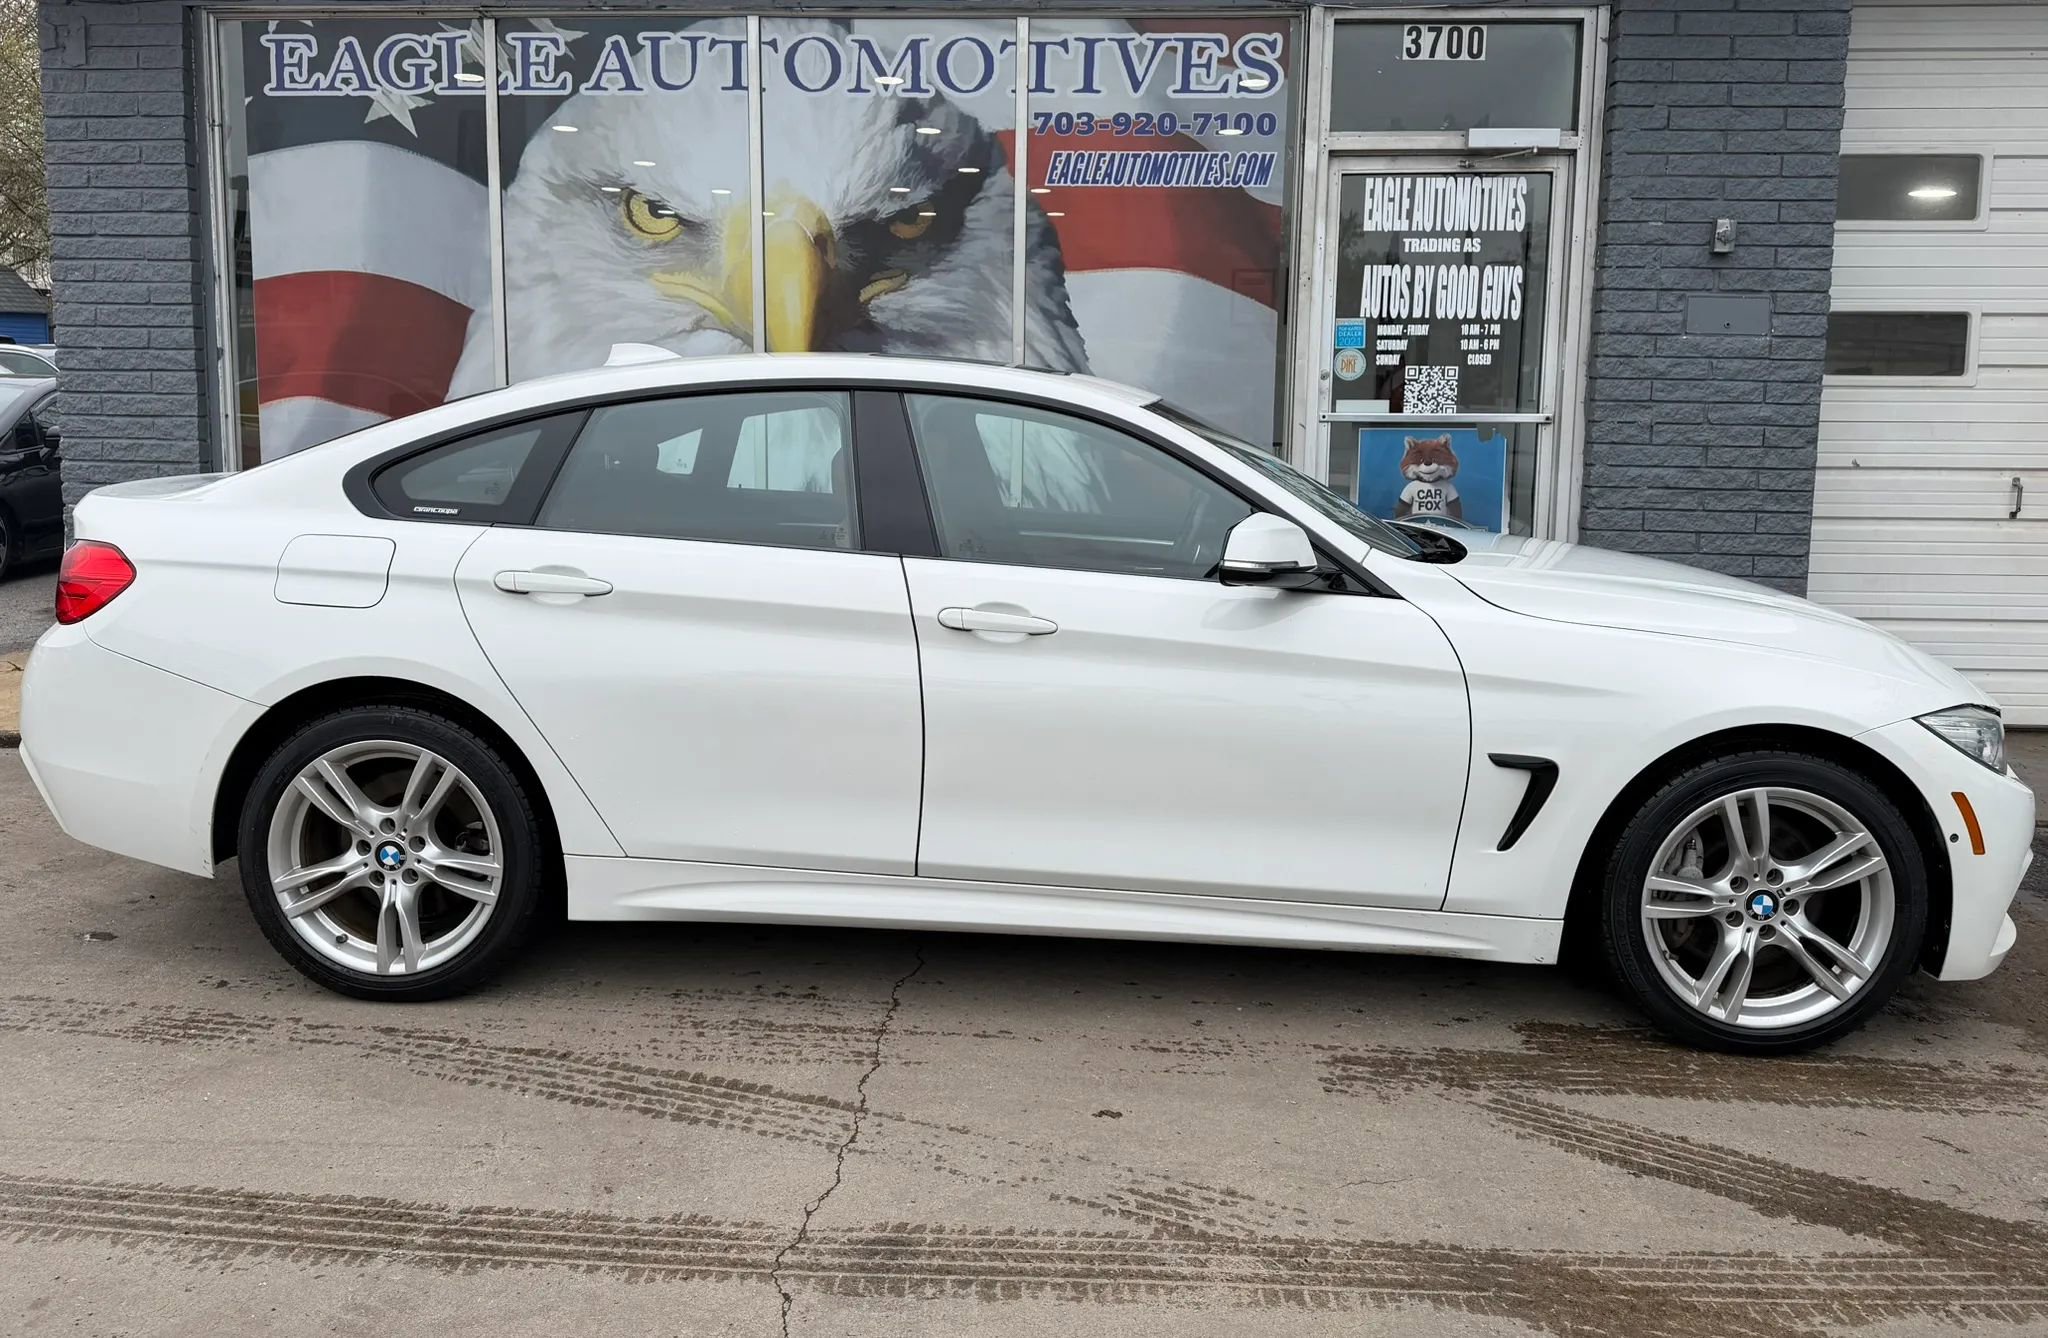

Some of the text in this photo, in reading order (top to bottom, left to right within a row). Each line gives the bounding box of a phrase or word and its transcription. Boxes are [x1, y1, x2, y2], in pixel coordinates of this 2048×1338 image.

[1405, 25, 1485, 60] 3700
[264, 33, 1283, 98] EAGLE AUTOMOTIVES
[1034, 111, 1277, 137] 703-920-7100
[1046, 151, 1277, 188] EAGLEAUTOMOTIVES.COM
[1363, 176, 1527, 232] EAGLE AUTOMOTIVES
[1403, 238, 1482, 253] TRADING AS
[1360, 264, 1523, 320] AUTOS BY GOOD GUYS
[1377, 324, 1403, 336] MONDAY
[1407, 324, 1430, 336] FRIDAY
[1461, 324, 1468, 336] 10
[1469, 324, 1480, 336] AM
[1484, 324, 1489, 336] 7
[1490, 324, 1501, 336] PM
[1338, 337, 1362, 346] 2021
[1376, 339, 1408, 351] SATURDAY
[1460, 339, 1468, 351] 10
[1468, 339, 1479, 351] AM
[1489, 339, 1500, 351] PM
[1375, 354, 1492, 366] SUNDAY CLOSED
[1417, 489, 1442, 500] CAR
[1418, 500, 1441, 511] FOX
